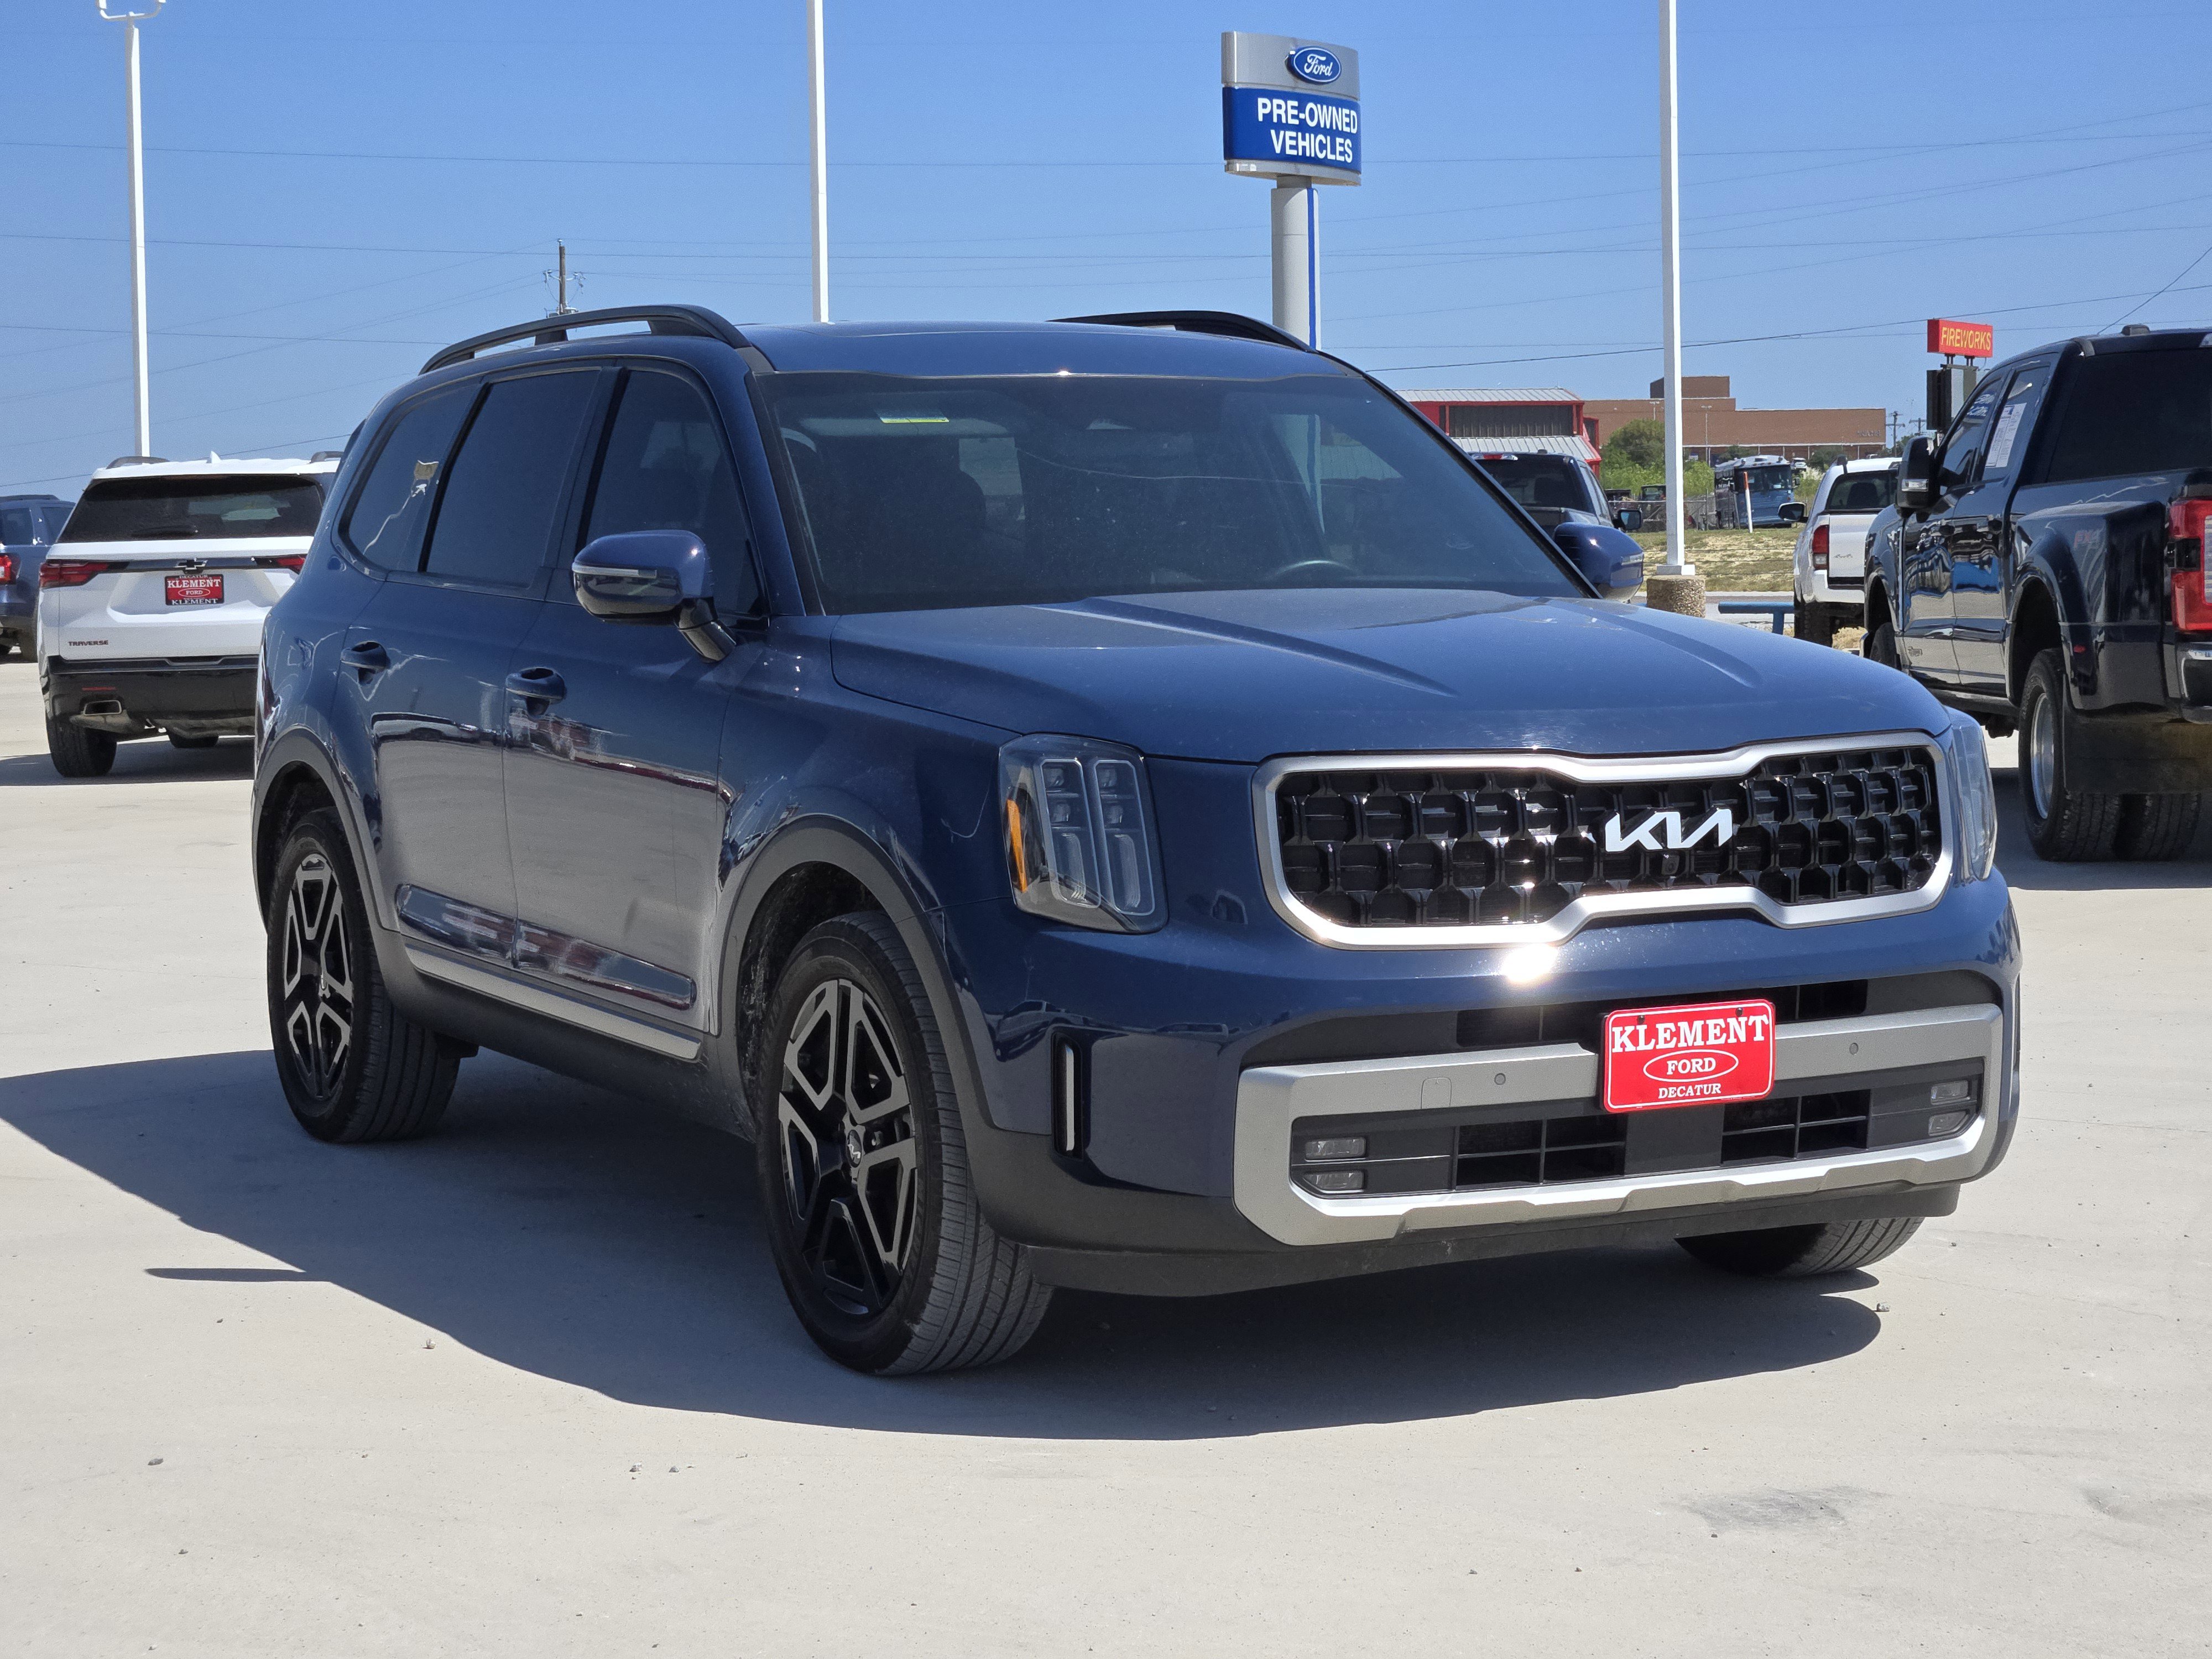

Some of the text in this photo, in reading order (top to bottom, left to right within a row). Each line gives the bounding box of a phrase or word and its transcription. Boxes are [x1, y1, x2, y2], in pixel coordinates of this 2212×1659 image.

[1304, 54, 1333, 76] Ford
[1258, 97, 1358, 134] PRE-OWNED
[1270, 129, 1353, 163] VEHICLES
[1942, 327, 1991, 351] FIREWORKS
[168, 579, 221, 588] KLEMENT
[1605, 808, 1733, 852] KIA
[1612, 1014, 1768, 1053] KLEMENT
[1666, 1057, 1716, 1075] FORD
[1658, 1083, 1721, 1099] DECATUR
